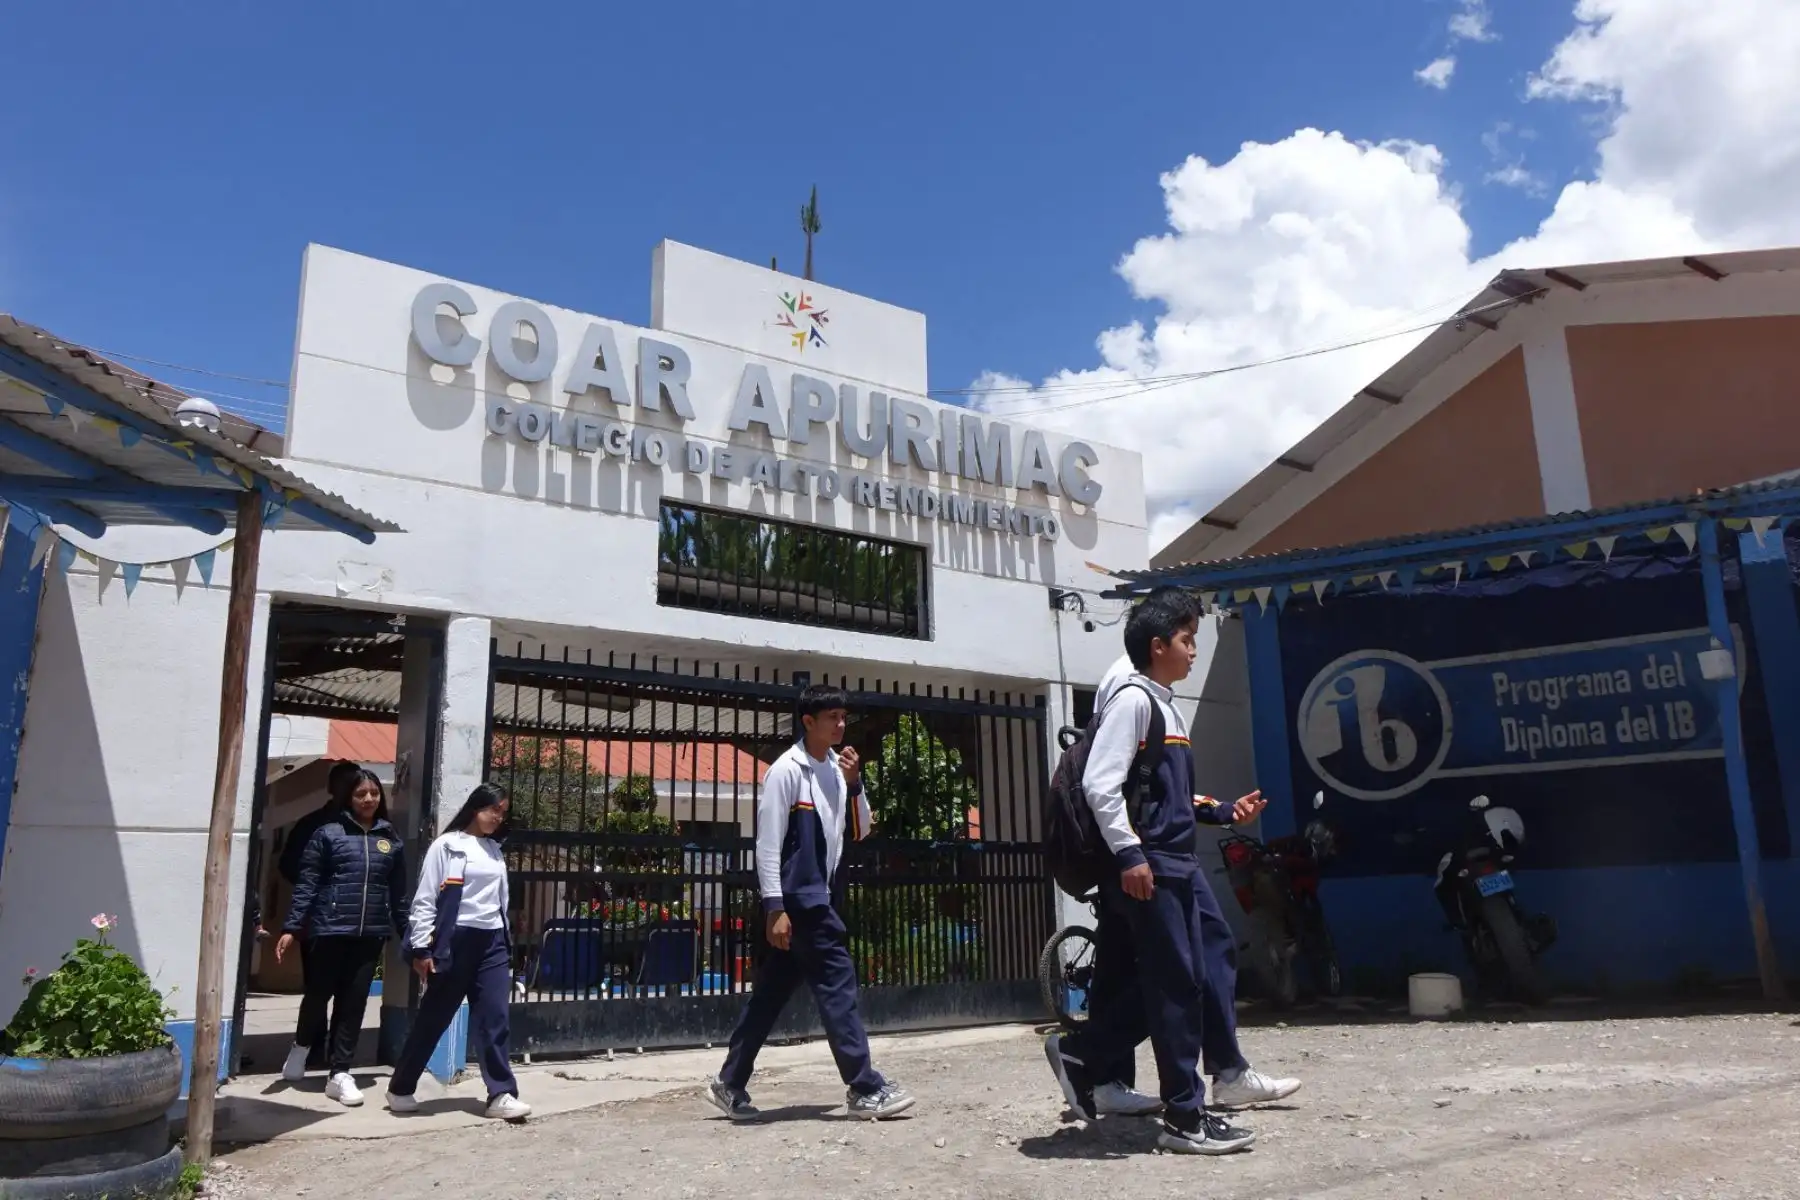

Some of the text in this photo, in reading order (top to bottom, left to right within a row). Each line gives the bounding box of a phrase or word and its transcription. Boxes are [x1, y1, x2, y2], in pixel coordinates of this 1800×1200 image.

[412, 282, 1103, 506] COAR APURIMAC
[485, 402, 1059, 542] COLEGIO DE ALTO RENDIMIENTO
[1492, 650, 1685, 709] Programa del
[1501, 701, 1696, 760] Diploma del IB
